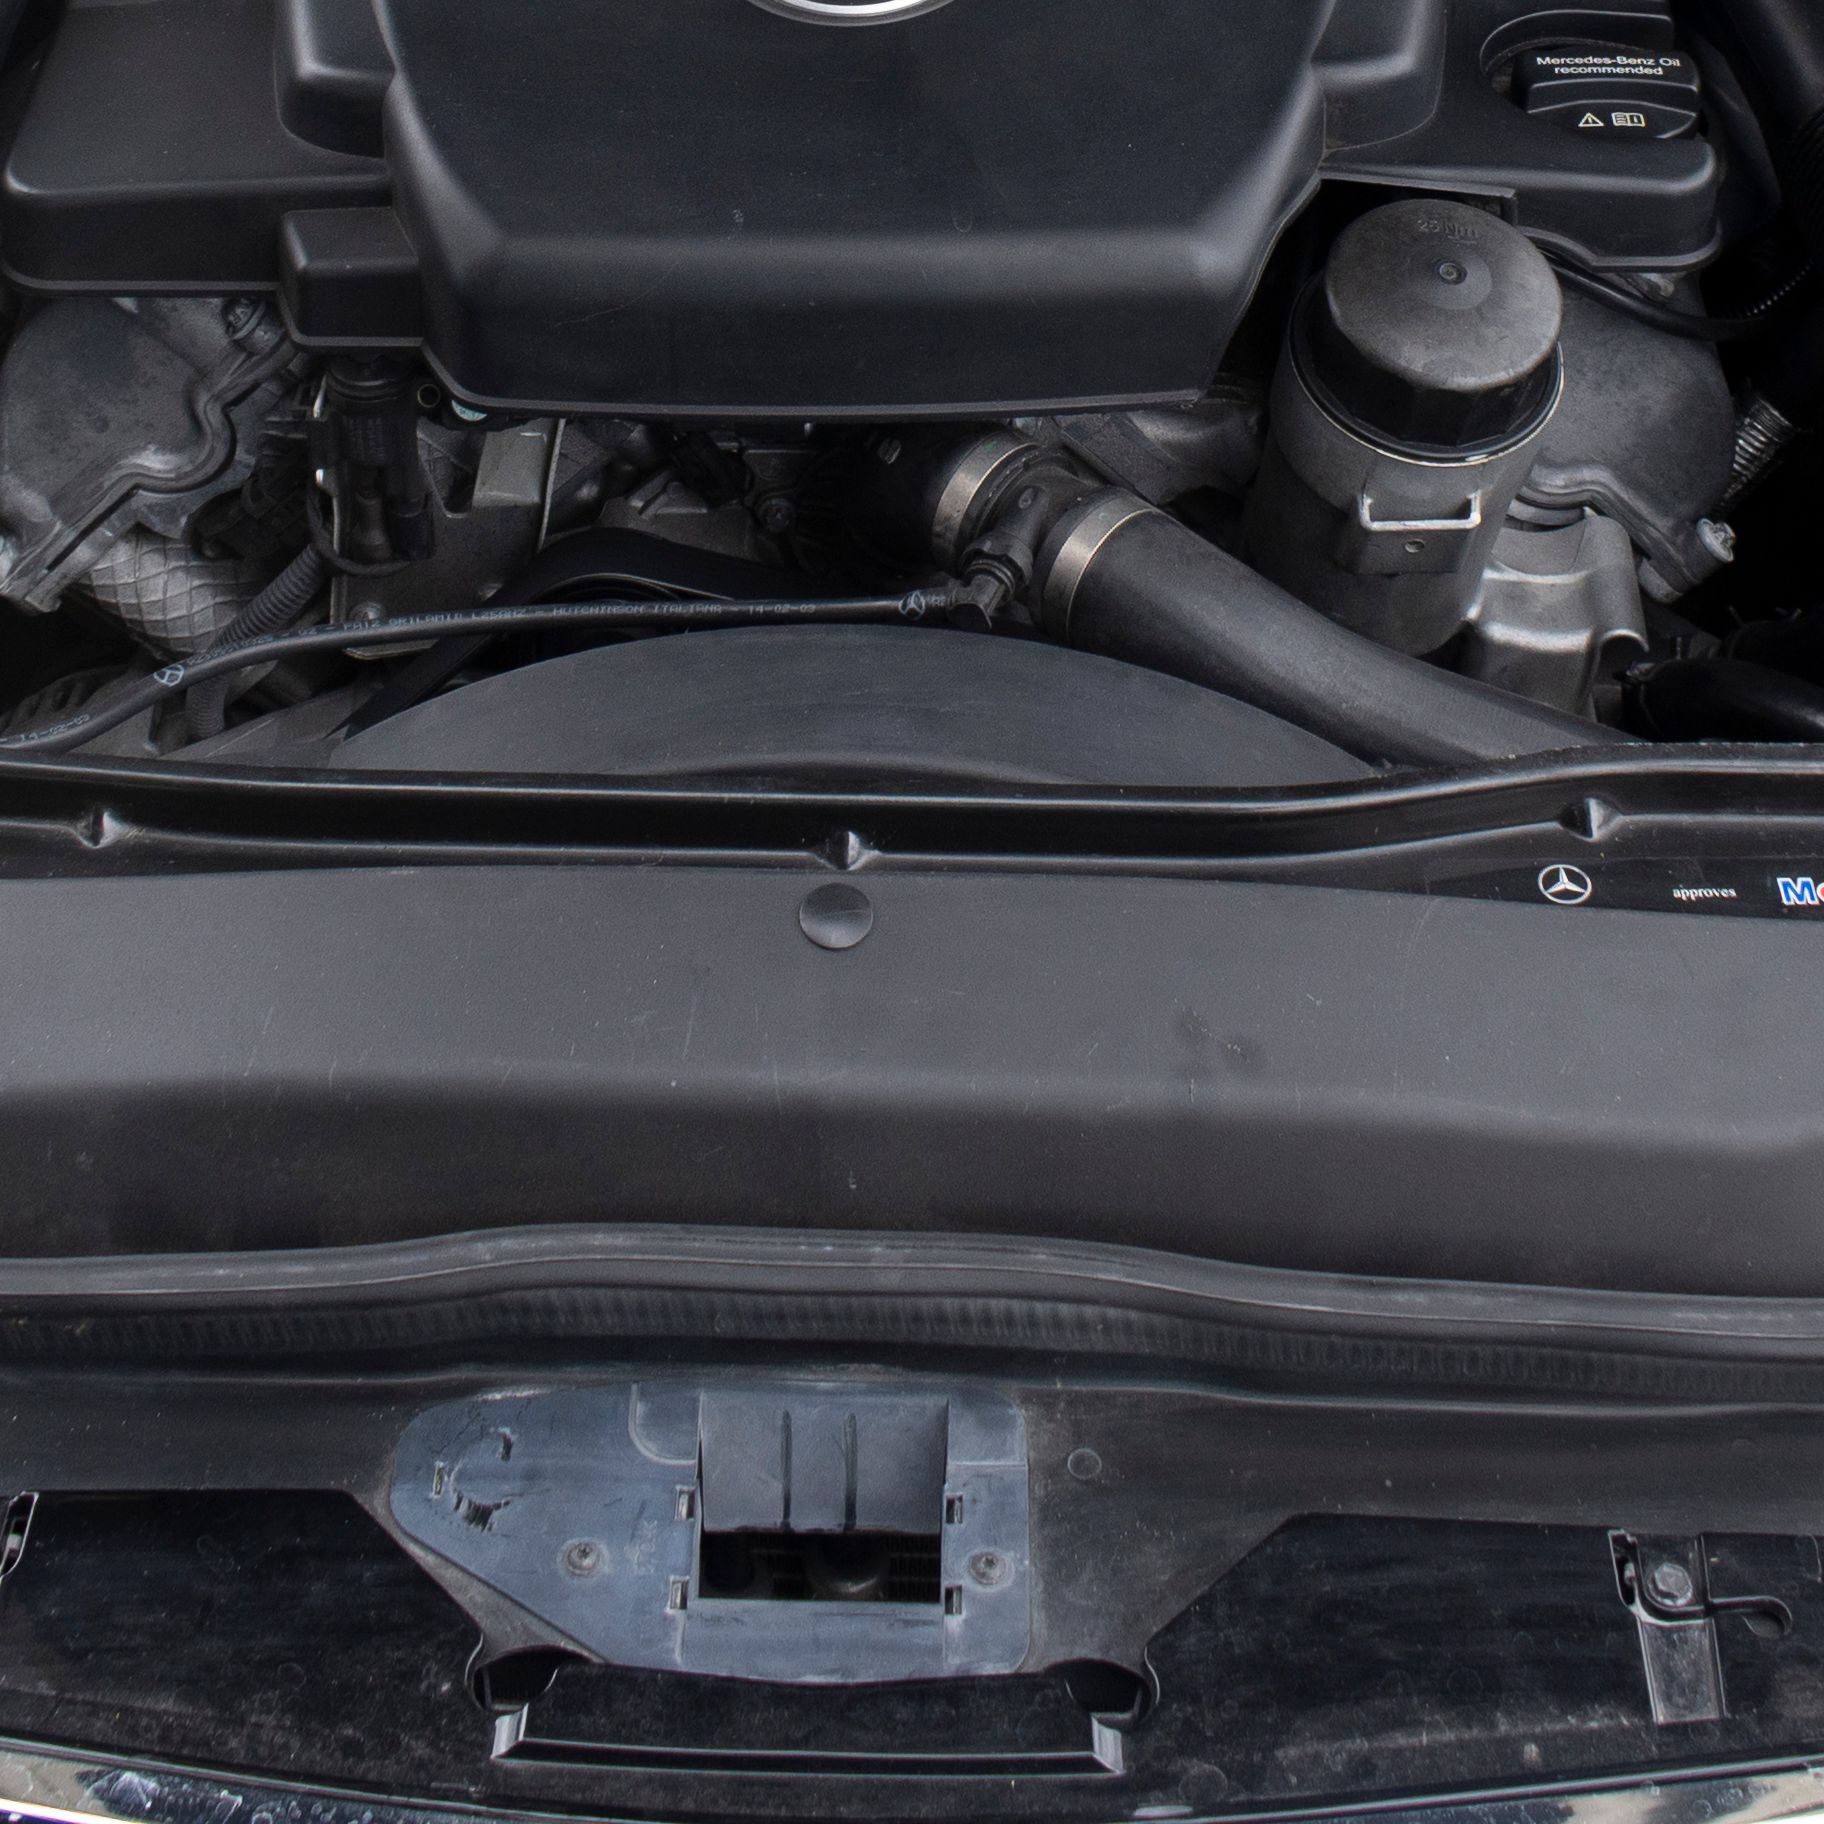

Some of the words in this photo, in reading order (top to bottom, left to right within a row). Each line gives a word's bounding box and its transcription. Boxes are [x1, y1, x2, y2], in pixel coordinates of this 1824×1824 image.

[1536, 55, 1655, 67] Mercedes-Benz
[1659, 56, 1681, 67] Oil
[1554, 65, 1664, 76] recommended
[1417, 218, 1440, 233] 25
[1443, 220, 1479, 239] Nm
[553, 605, 643, 616] HUTCHINSON
[653, 603, 721, 614] ITALIANA
[749, 603, 815, 614] 14-02-03
[1672, 884, 1736, 901] approves
